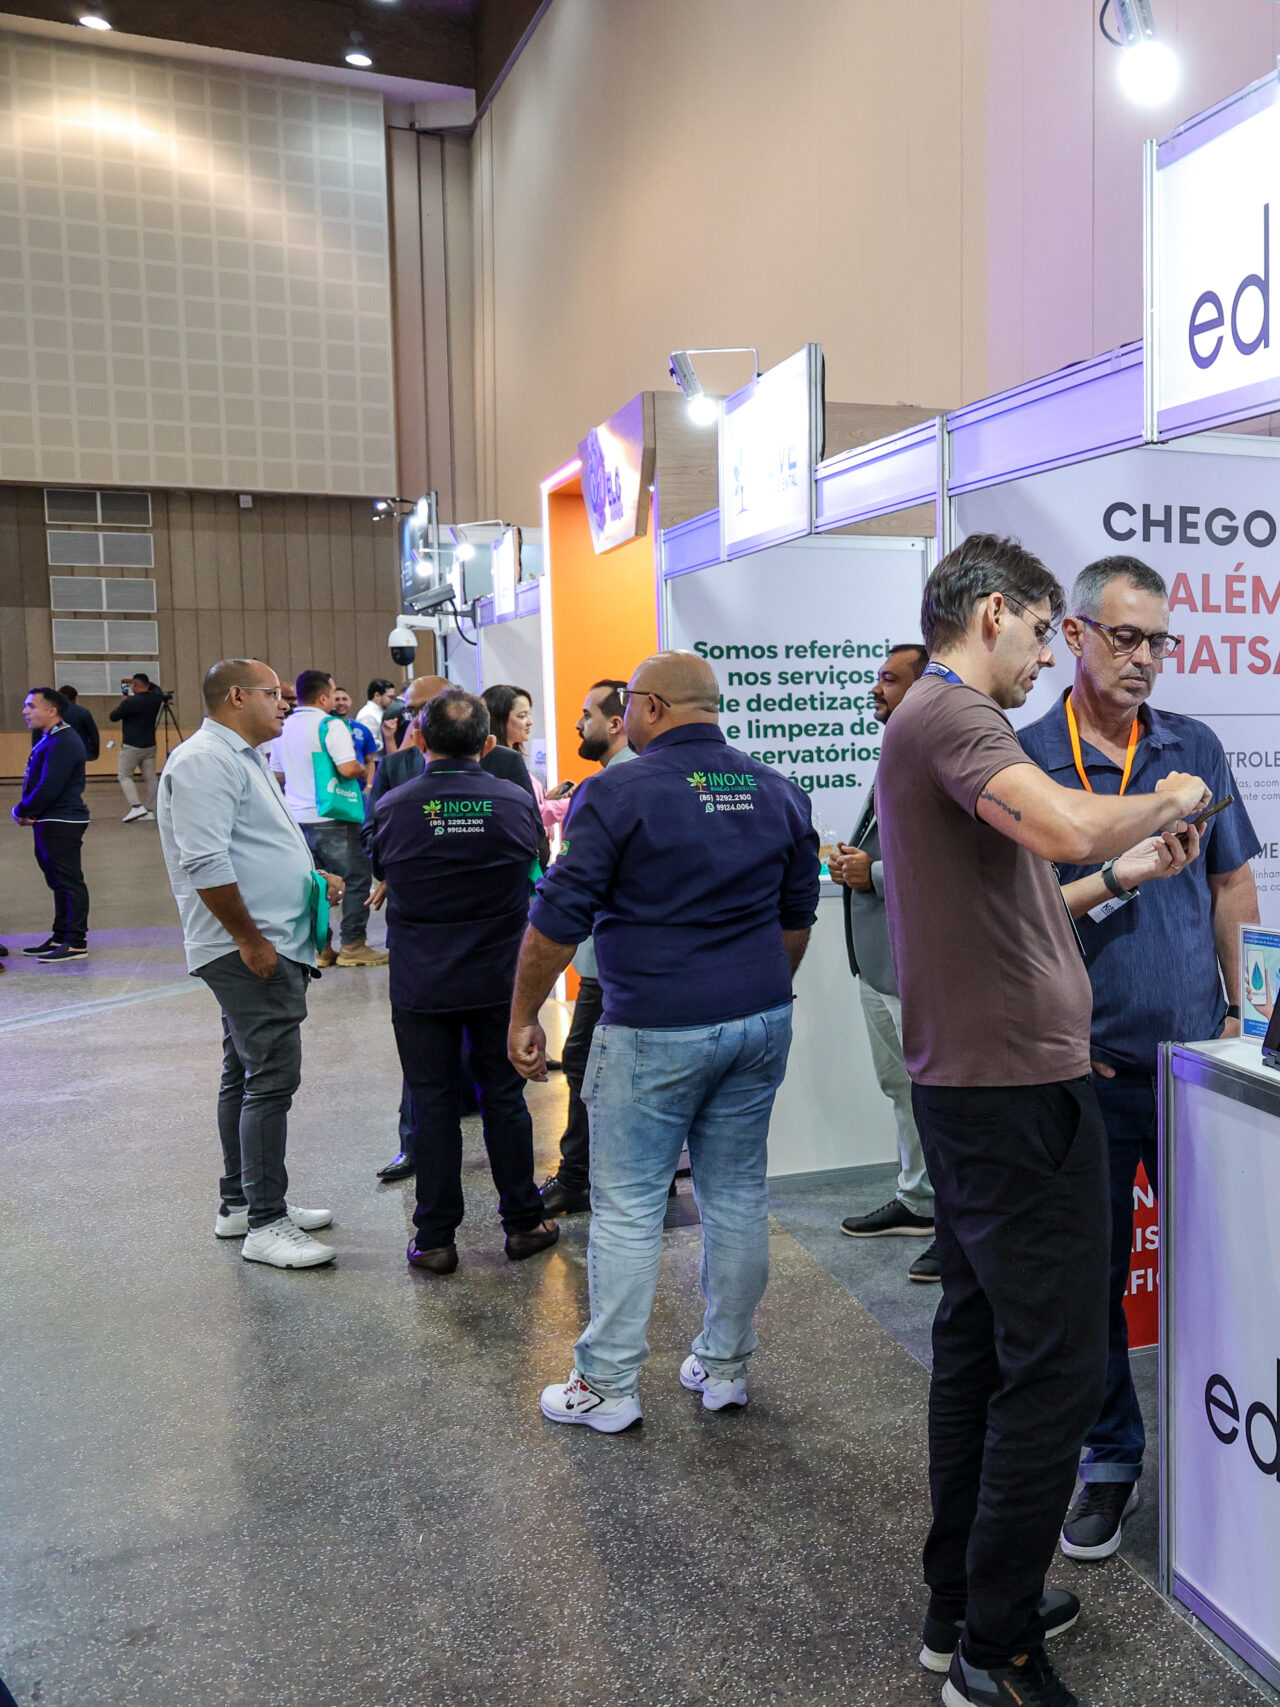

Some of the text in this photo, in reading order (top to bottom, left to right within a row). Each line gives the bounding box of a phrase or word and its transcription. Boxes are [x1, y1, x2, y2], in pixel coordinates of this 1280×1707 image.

[693, 641, 779, 660] Somos
[728, 665, 875, 689] nos serviços
[726, 717, 880, 742] e limpeza de
[707, 772, 757, 786] INOVE
[699, 793, 714, 802] (85)
[444, 801, 493, 812] INOVE
